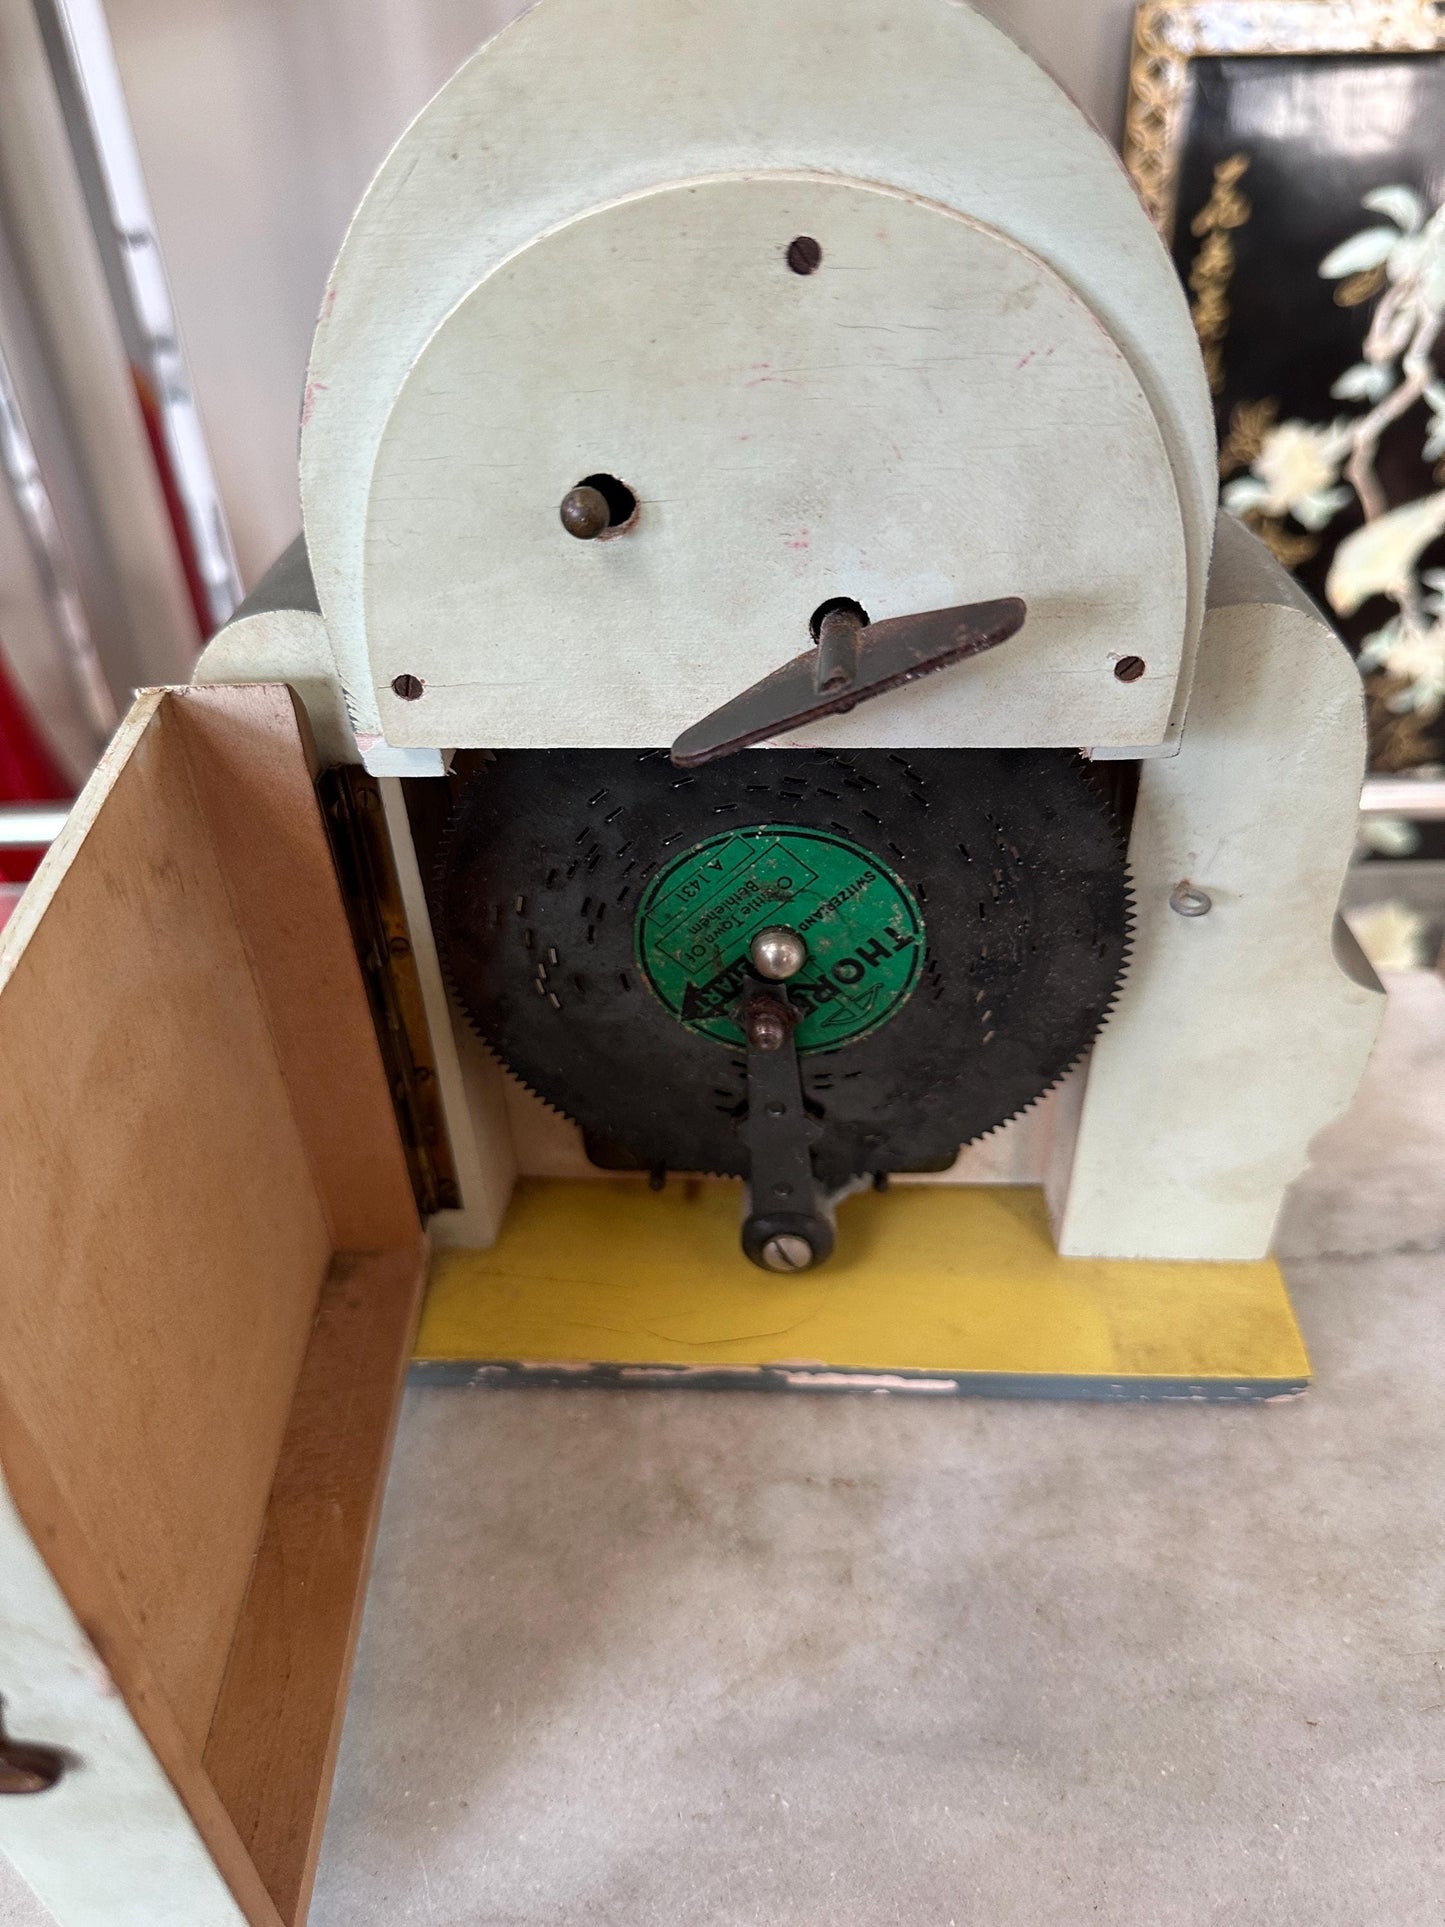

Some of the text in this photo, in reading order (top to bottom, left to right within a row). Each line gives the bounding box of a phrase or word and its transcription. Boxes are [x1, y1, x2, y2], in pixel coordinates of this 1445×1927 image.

[676, 859, 723, 902] A 1431
[799, 870, 876, 931] SWITZERLAND
[688, 881, 760, 934] Bethlehem
[704, 911, 744, 944] Town
[684, 944, 705, 963] Of
[786, 926, 914, 1018] THORE
